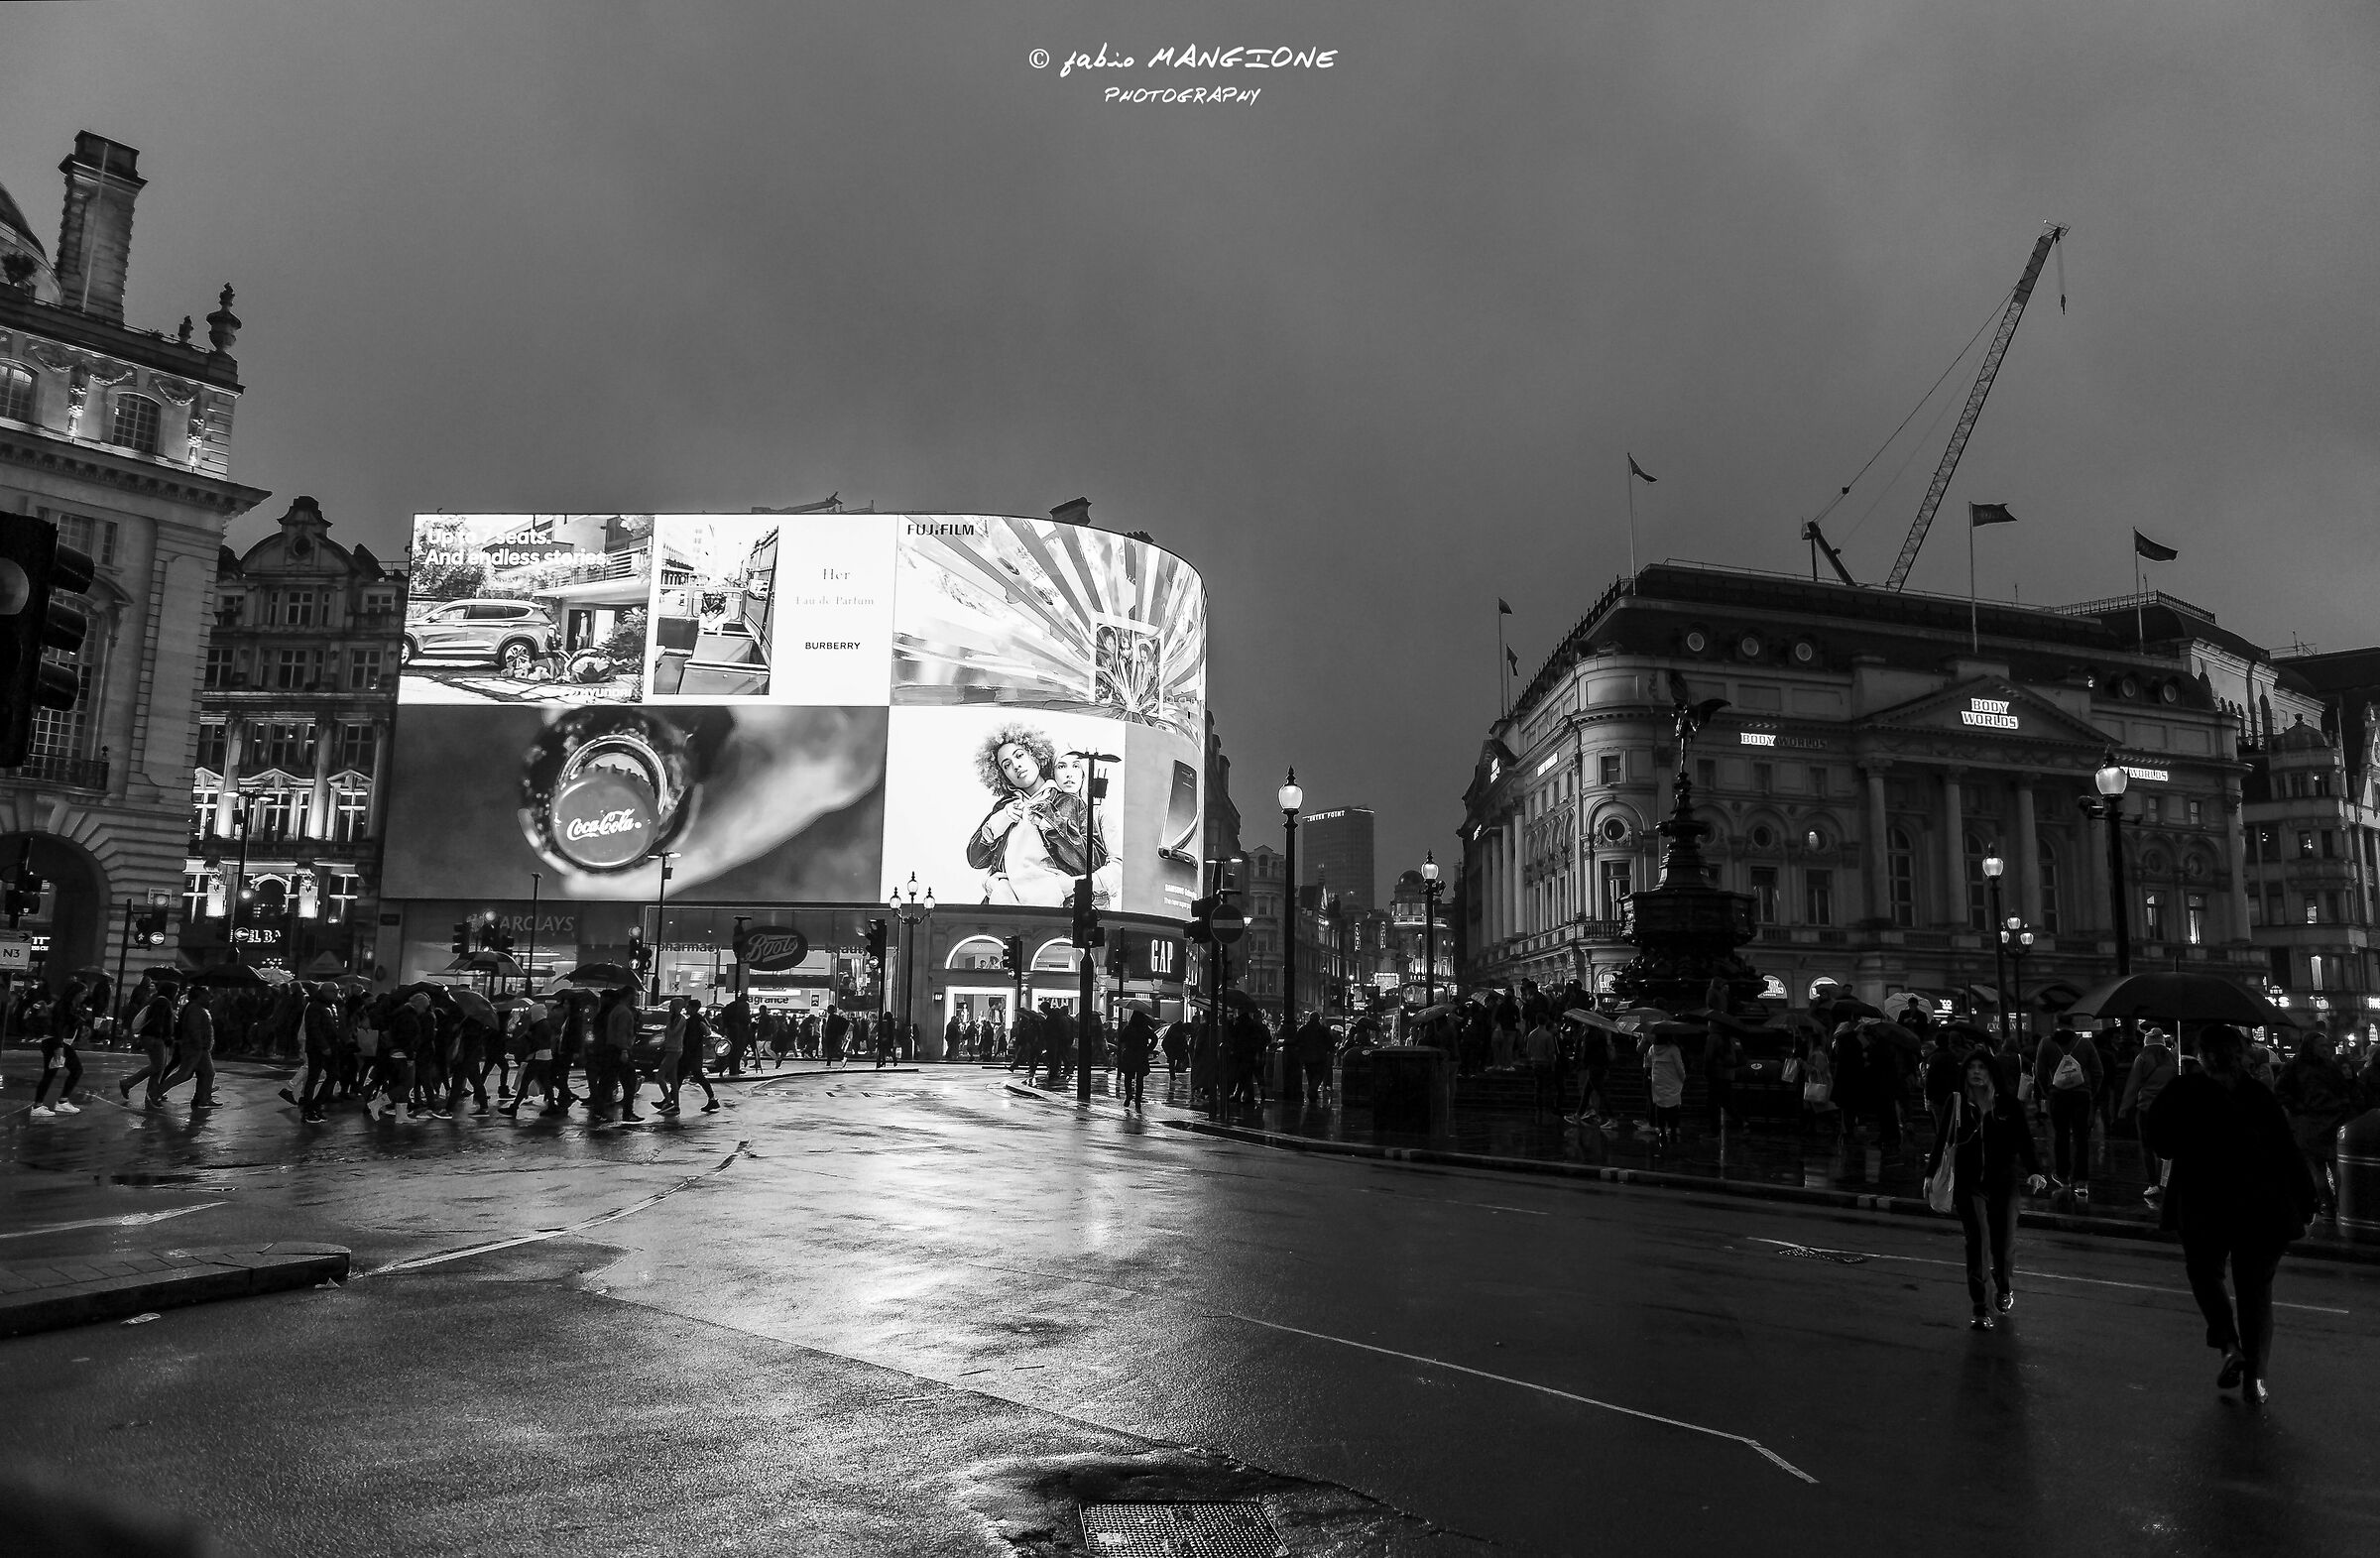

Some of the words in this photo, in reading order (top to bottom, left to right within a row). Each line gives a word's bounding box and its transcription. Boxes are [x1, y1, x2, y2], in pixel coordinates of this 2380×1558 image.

[427, 529, 453, 547] Up
[495, 529, 552, 544] seats.
[907, 524, 975, 536] FUJIFILM
[425, 548, 464, 565] And
[467, 547, 539, 565] endless
[543, 547, 612, 565] stories.
[823, 568, 850, 580] Her
[836, 595, 874, 606] Parfum
[804, 642, 861, 651] BURBERRY
[1970, 698, 2010, 714] BODY
[1961, 711, 2019, 730] WORLDS
[1740, 733, 1777, 747] BODY
[1777, 736, 1829, 750] WORLDS
[2129, 768, 2169, 781] WORLDS
[499, 914, 575, 932] ARCLAYS
[3, 948, 21, 958] N3
[744, 933, 798, 963] Boots
[1150, 939, 1173, 974] GAP
